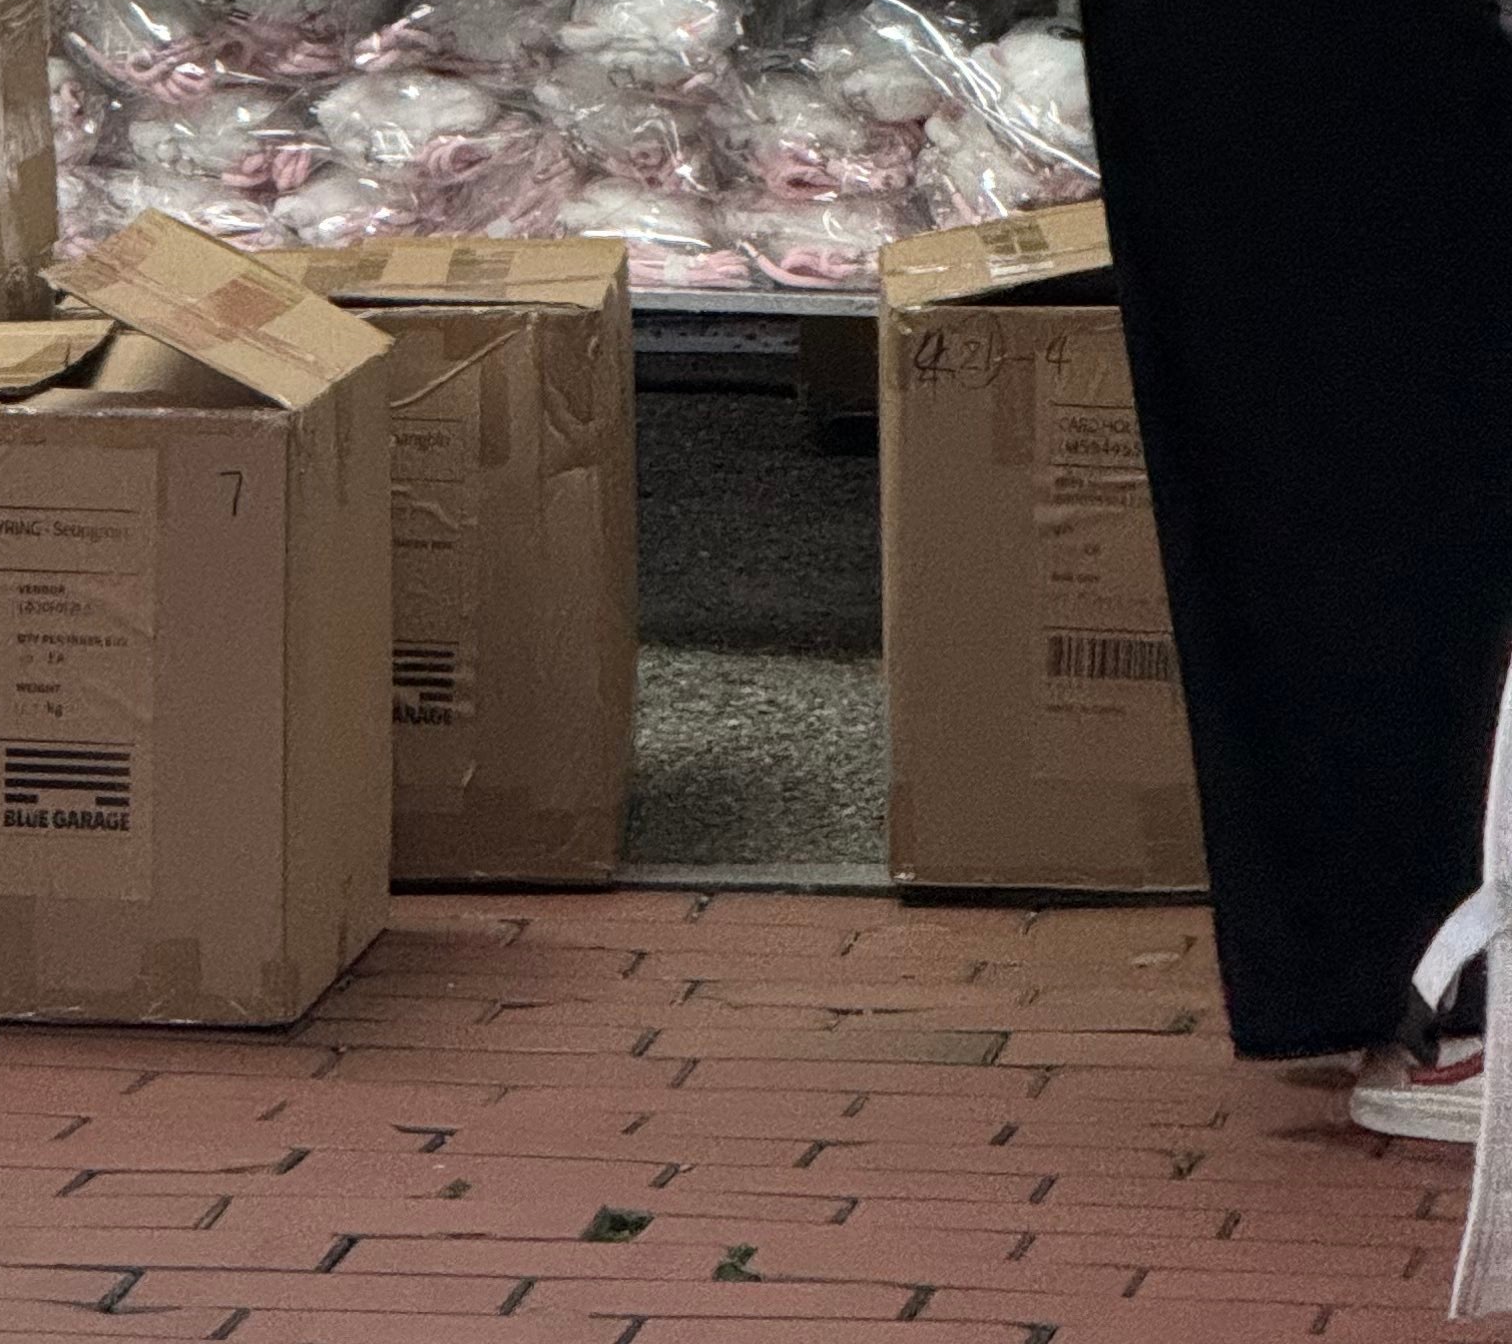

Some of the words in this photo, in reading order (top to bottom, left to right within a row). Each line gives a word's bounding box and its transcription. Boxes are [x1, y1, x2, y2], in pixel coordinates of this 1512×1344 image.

[219, 470, 244, 518] 7
[3, 808, 48, 830] BLUE
[51, 809, 131, 833] GARAGE
